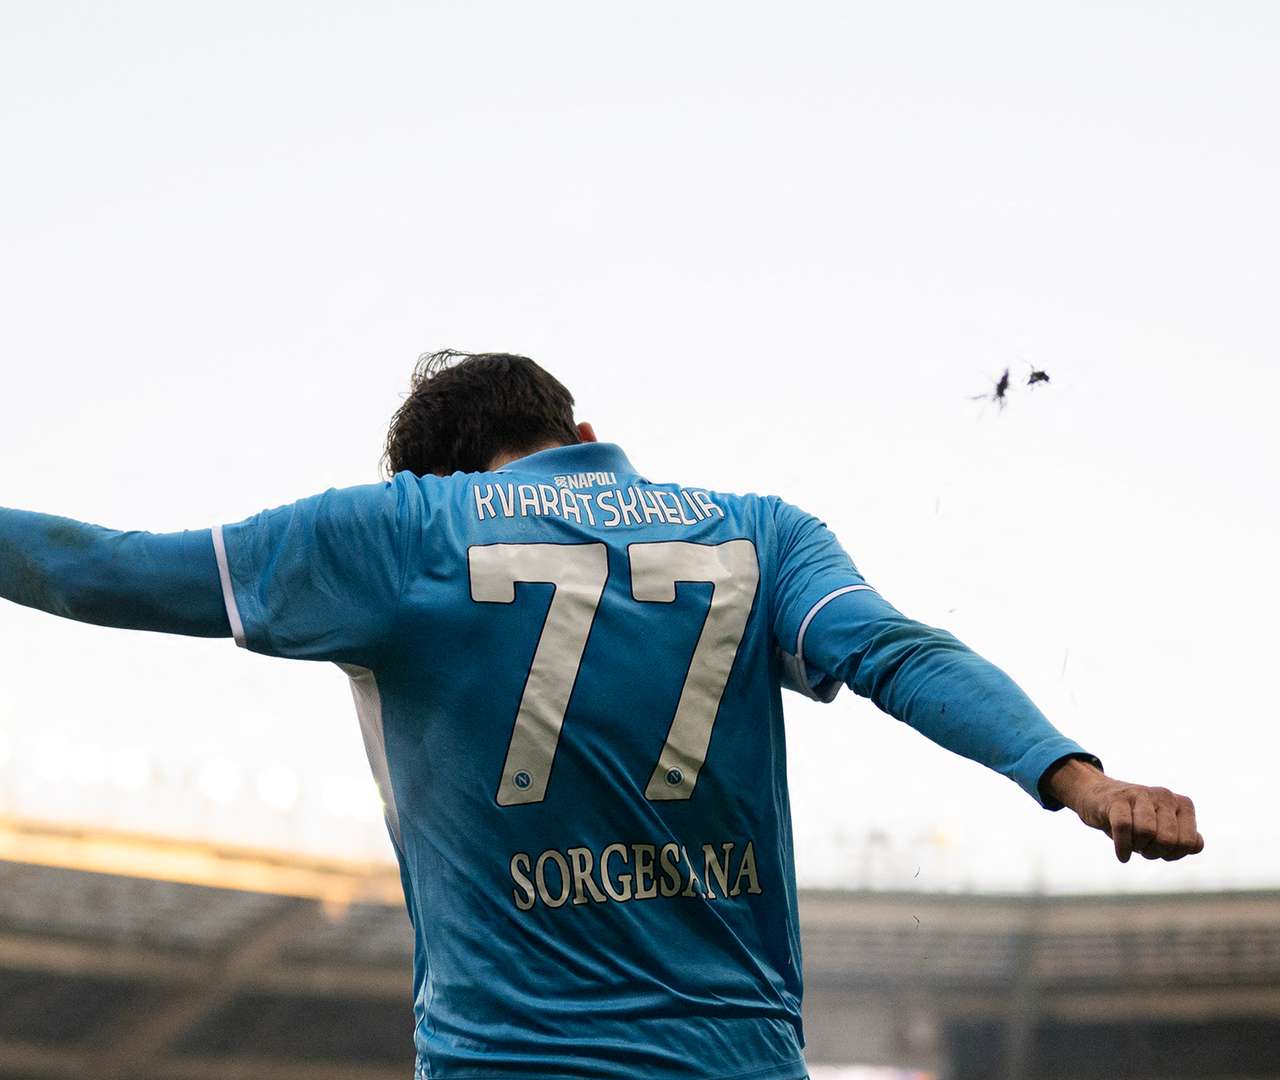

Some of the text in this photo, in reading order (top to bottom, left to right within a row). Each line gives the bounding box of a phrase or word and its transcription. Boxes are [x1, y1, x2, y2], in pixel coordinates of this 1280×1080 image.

[473, 483, 724, 527] KVARATSKHELIA
[567, 471, 617, 490] NAPOLI
[467, 539, 761, 807] 77
[509, 841, 763, 911] SORGESANA
